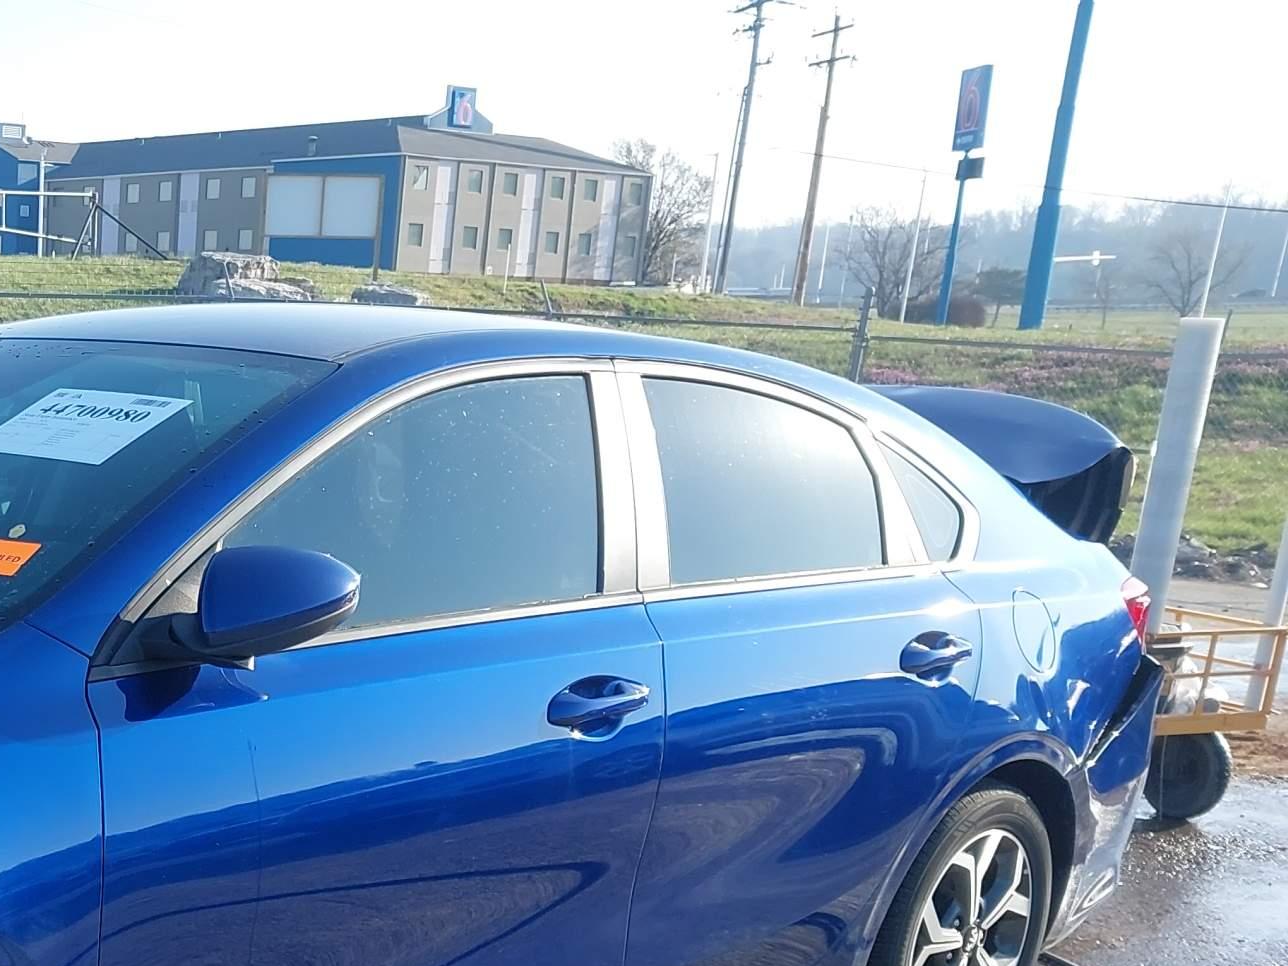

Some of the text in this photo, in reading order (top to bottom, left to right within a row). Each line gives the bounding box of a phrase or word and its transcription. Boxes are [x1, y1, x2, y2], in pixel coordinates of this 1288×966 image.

[456, 94, 473, 126] 6
[960, 71, 982, 130] 6
[40, 402, 152, 423] 44700980
